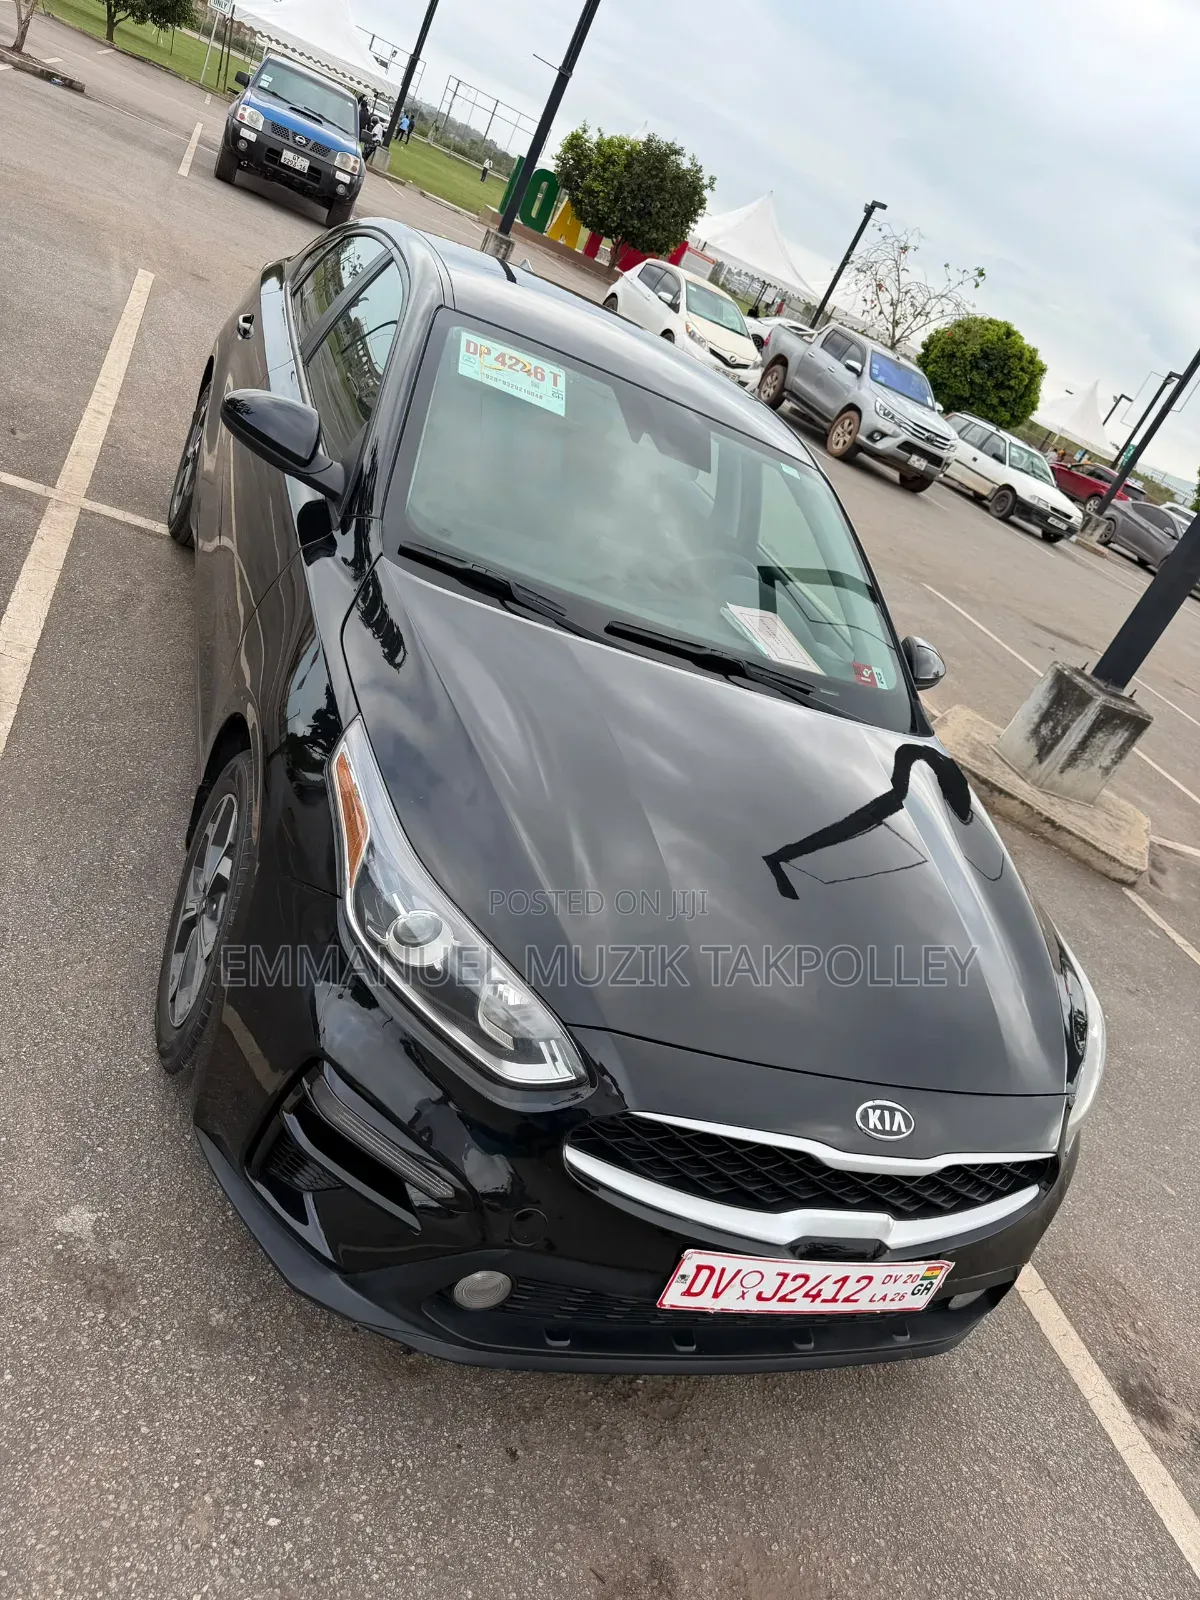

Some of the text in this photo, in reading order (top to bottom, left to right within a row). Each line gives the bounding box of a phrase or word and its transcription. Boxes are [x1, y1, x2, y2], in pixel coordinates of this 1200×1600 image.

[465, 339, 491, 359] DP
[549, 370, 562, 388] T
[867, 1108, 907, 1133] KIA
[680, 1264, 743, 1299] DV
[756, 1271, 874, 1304] J2412
[881, 1273, 920, 1285] DV 20
[868, 1292, 907, 1303] LA 26
